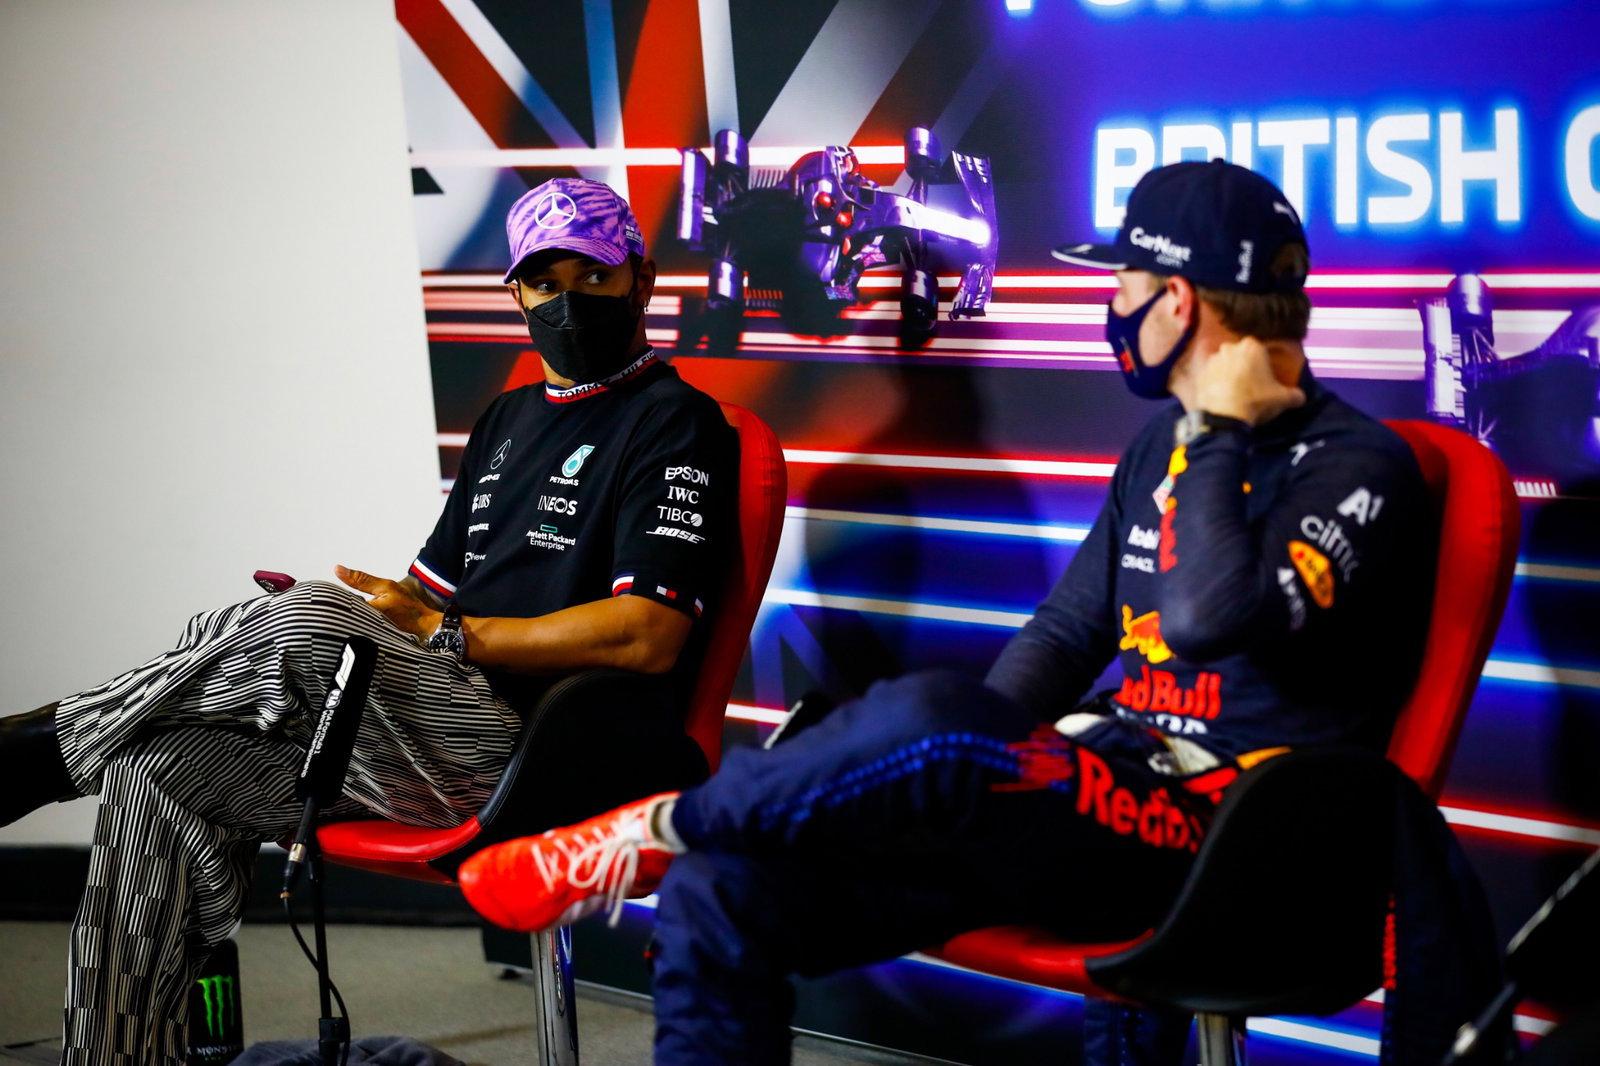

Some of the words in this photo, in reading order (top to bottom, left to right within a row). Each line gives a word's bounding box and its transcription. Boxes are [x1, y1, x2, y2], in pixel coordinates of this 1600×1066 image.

[665, 466, 709, 486] EPSON
[667, 485, 699, 504] IWC
[537, 495, 578, 516] INEOS
[657, 505, 703, 527] TIBCO
[526, 530, 548, 540] wlett
[548, 533, 576, 546] Packard
[530, 537, 565, 551] Enterprise
[646, 526, 705, 544] BOSE
[1150, 670, 1222, 720] Bull
